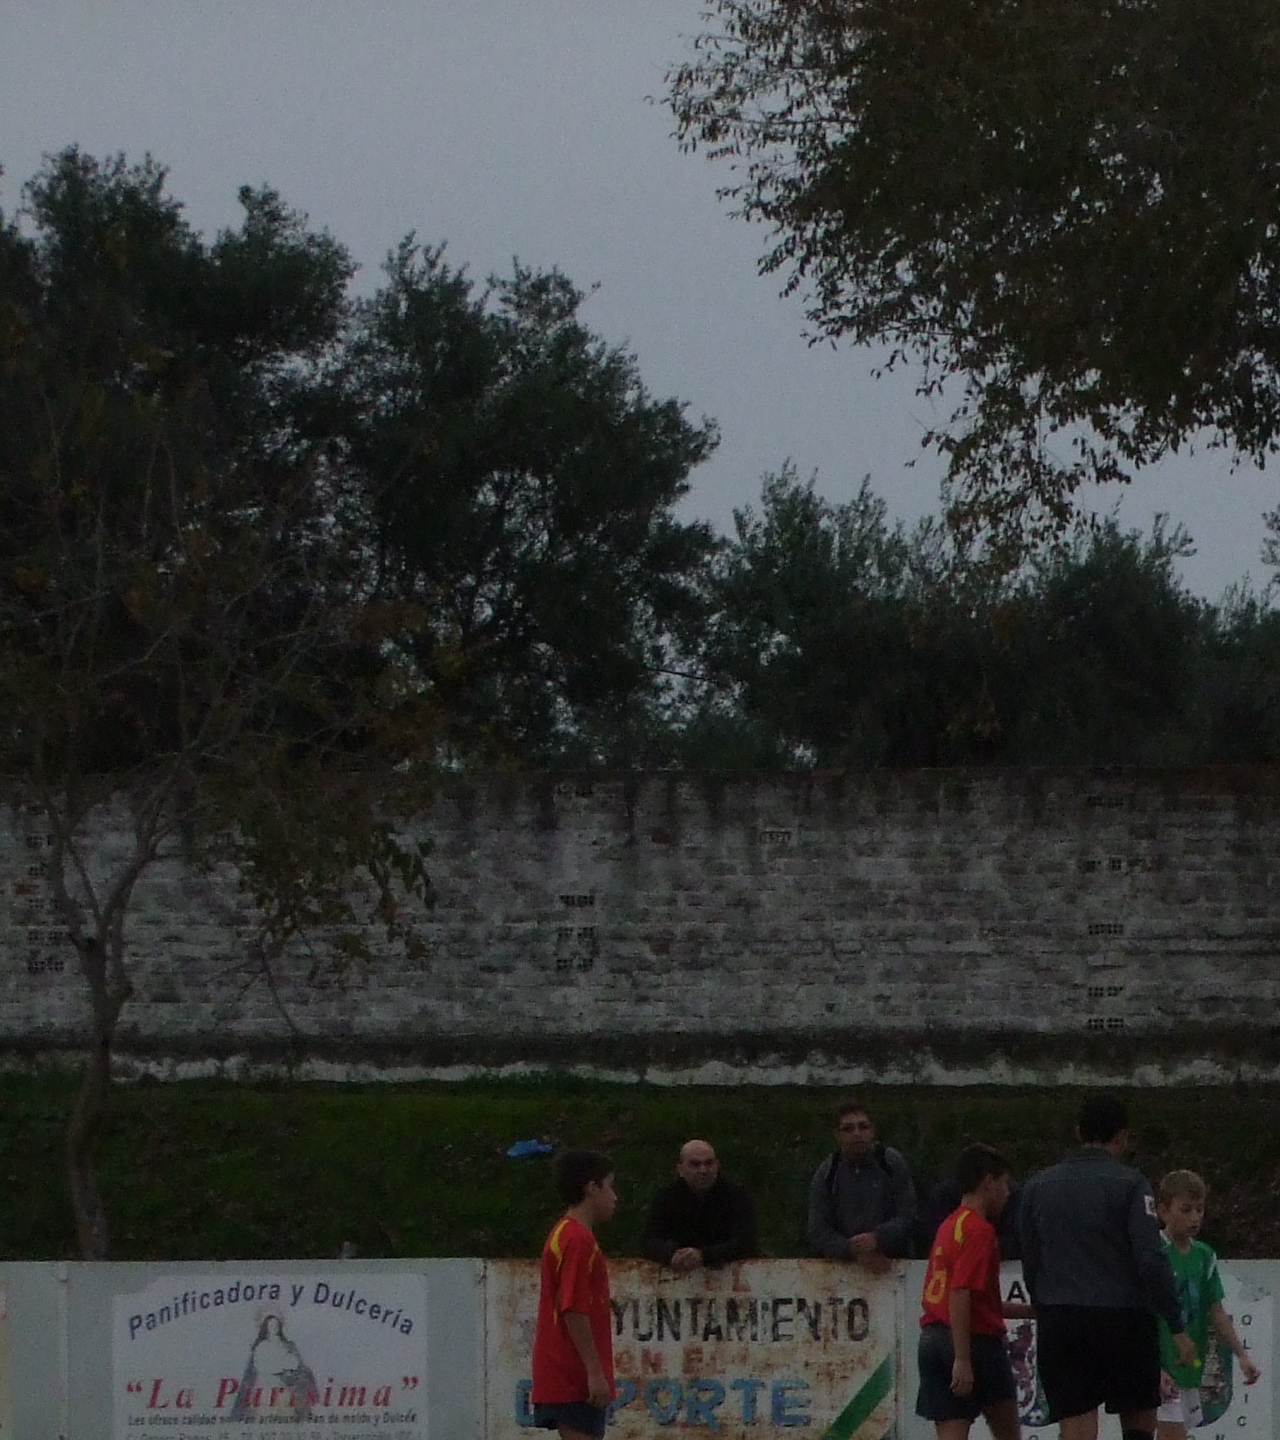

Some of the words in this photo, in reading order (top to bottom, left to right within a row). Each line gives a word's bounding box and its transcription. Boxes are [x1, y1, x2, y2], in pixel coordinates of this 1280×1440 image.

[128, 1281, 281, 1340] Panificadora
[289, 1282, 304, 1307] y
[313, 1281, 414, 1336] Dulcería
[611, 1297, 870, 1341] YUNTAMIENTO
